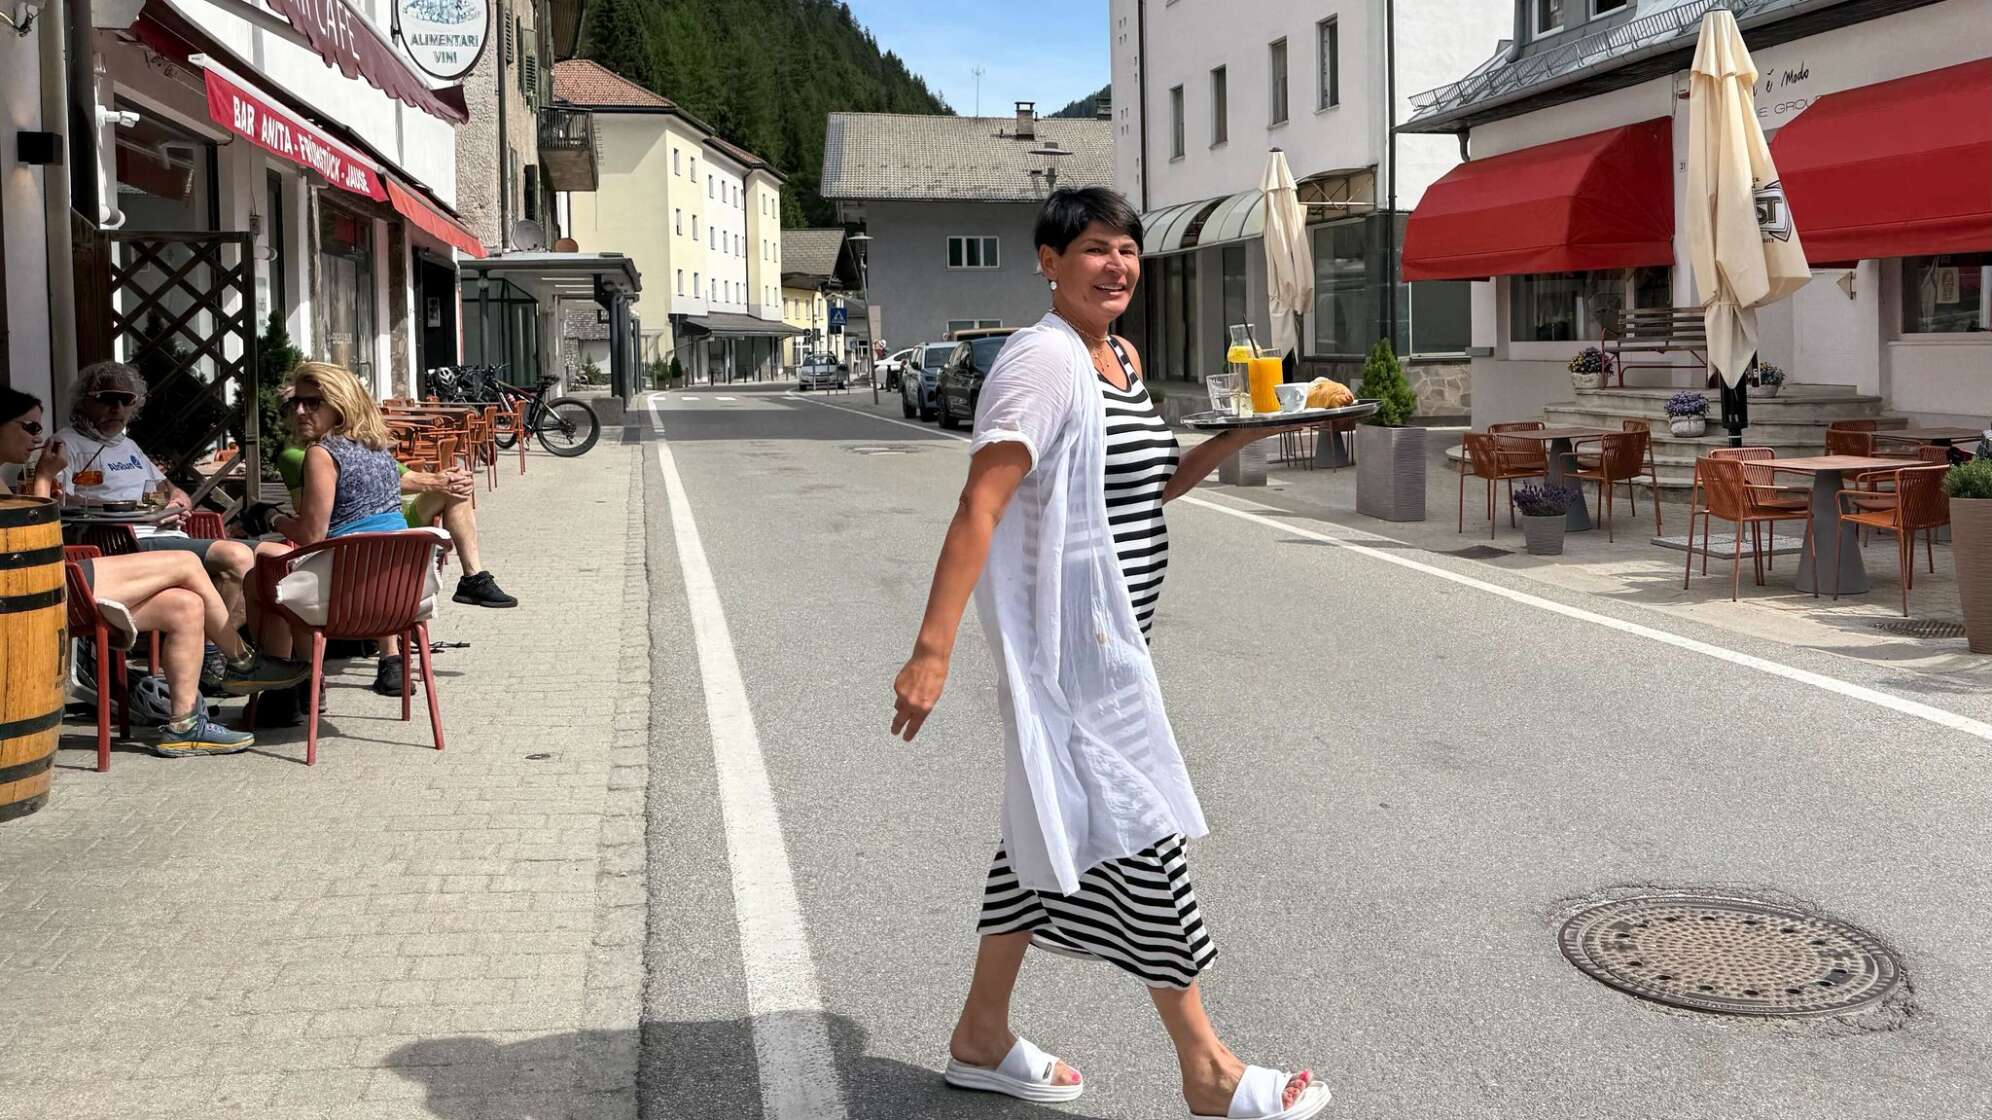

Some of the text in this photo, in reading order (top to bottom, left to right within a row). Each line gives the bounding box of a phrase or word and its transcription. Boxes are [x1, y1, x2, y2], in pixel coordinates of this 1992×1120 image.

[410, 34, 479, 47] ALIMENTARI
[433, 51, 457, 64] VINI
[233, 96, 255, 137] BAR
[261, 113, 293, 155] ANITA
[297, 133, 342, 183] FRÜHSTÜCK
[345, 163, 371, 194] JAUSE
